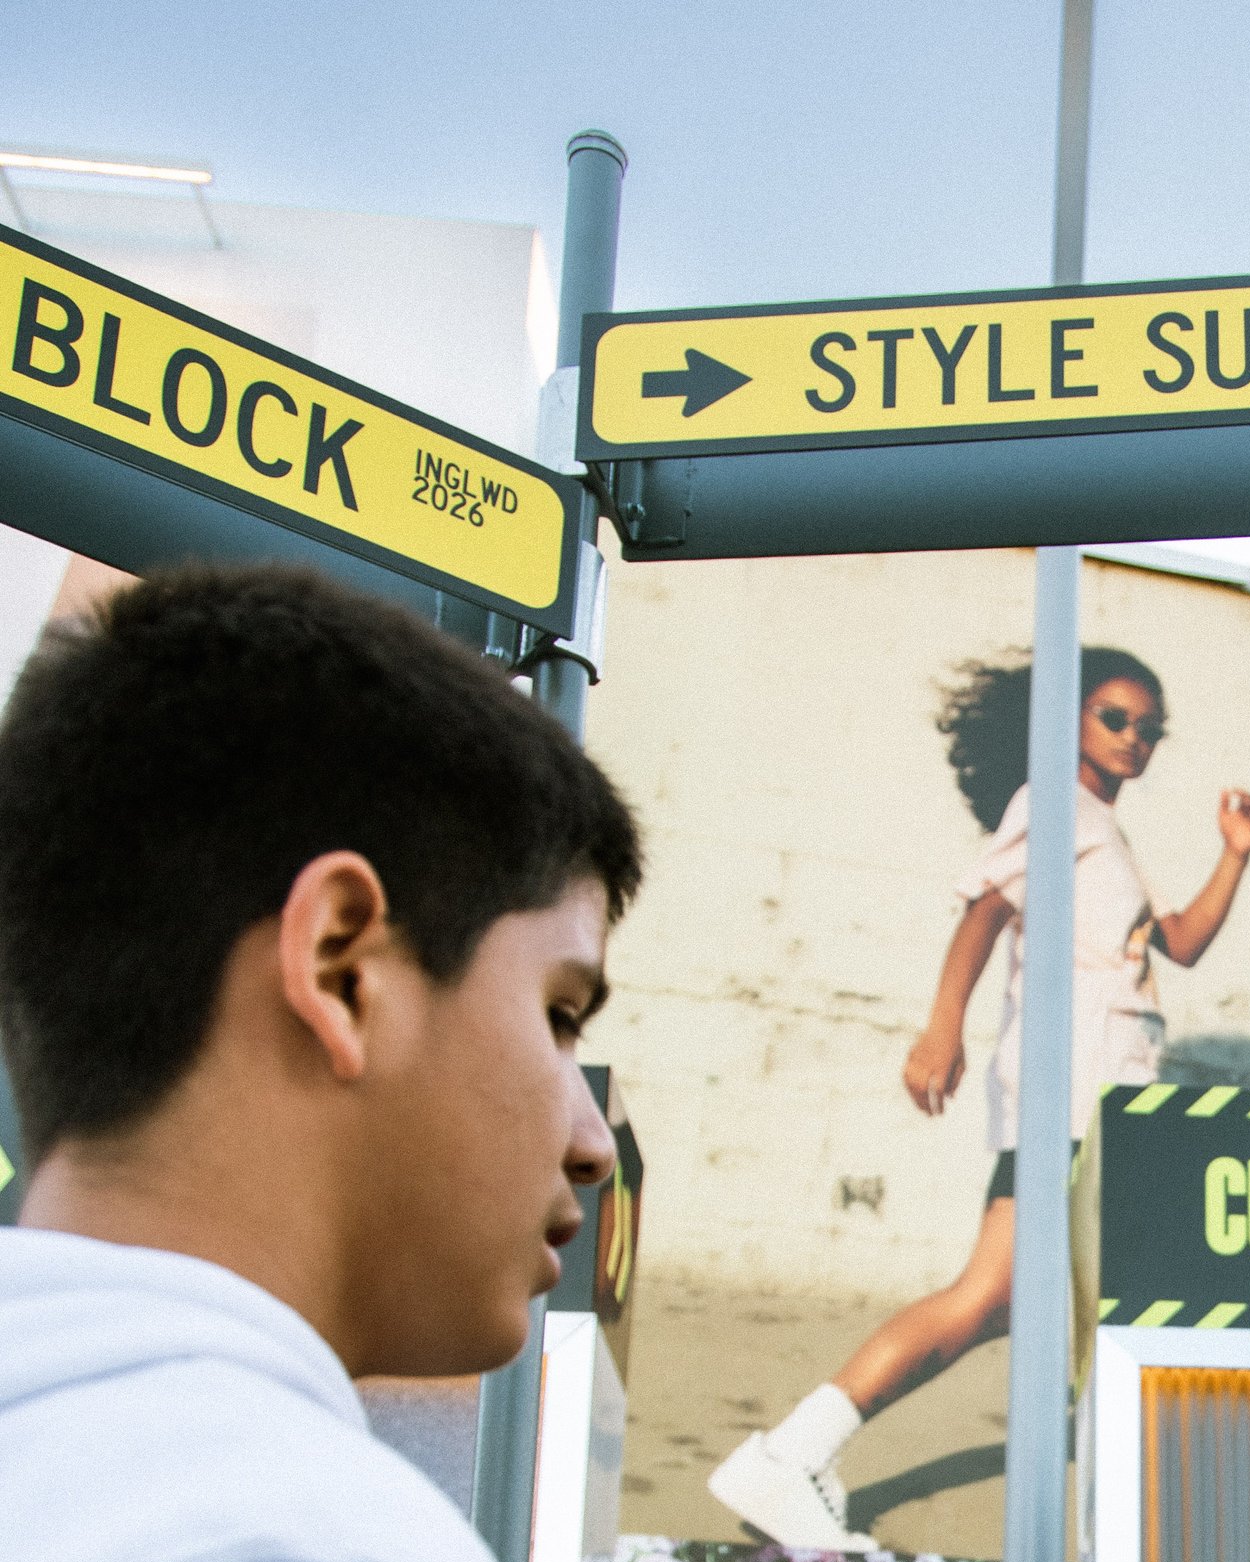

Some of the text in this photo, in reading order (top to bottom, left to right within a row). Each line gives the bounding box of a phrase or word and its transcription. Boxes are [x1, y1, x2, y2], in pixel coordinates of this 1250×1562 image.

[11, 276, 365, 512] BLOCK
[805, 317, 1099, 413] STYLE
[411, 475, 484, 527] 2026
[415, 448, 518, 514] INGLWD
